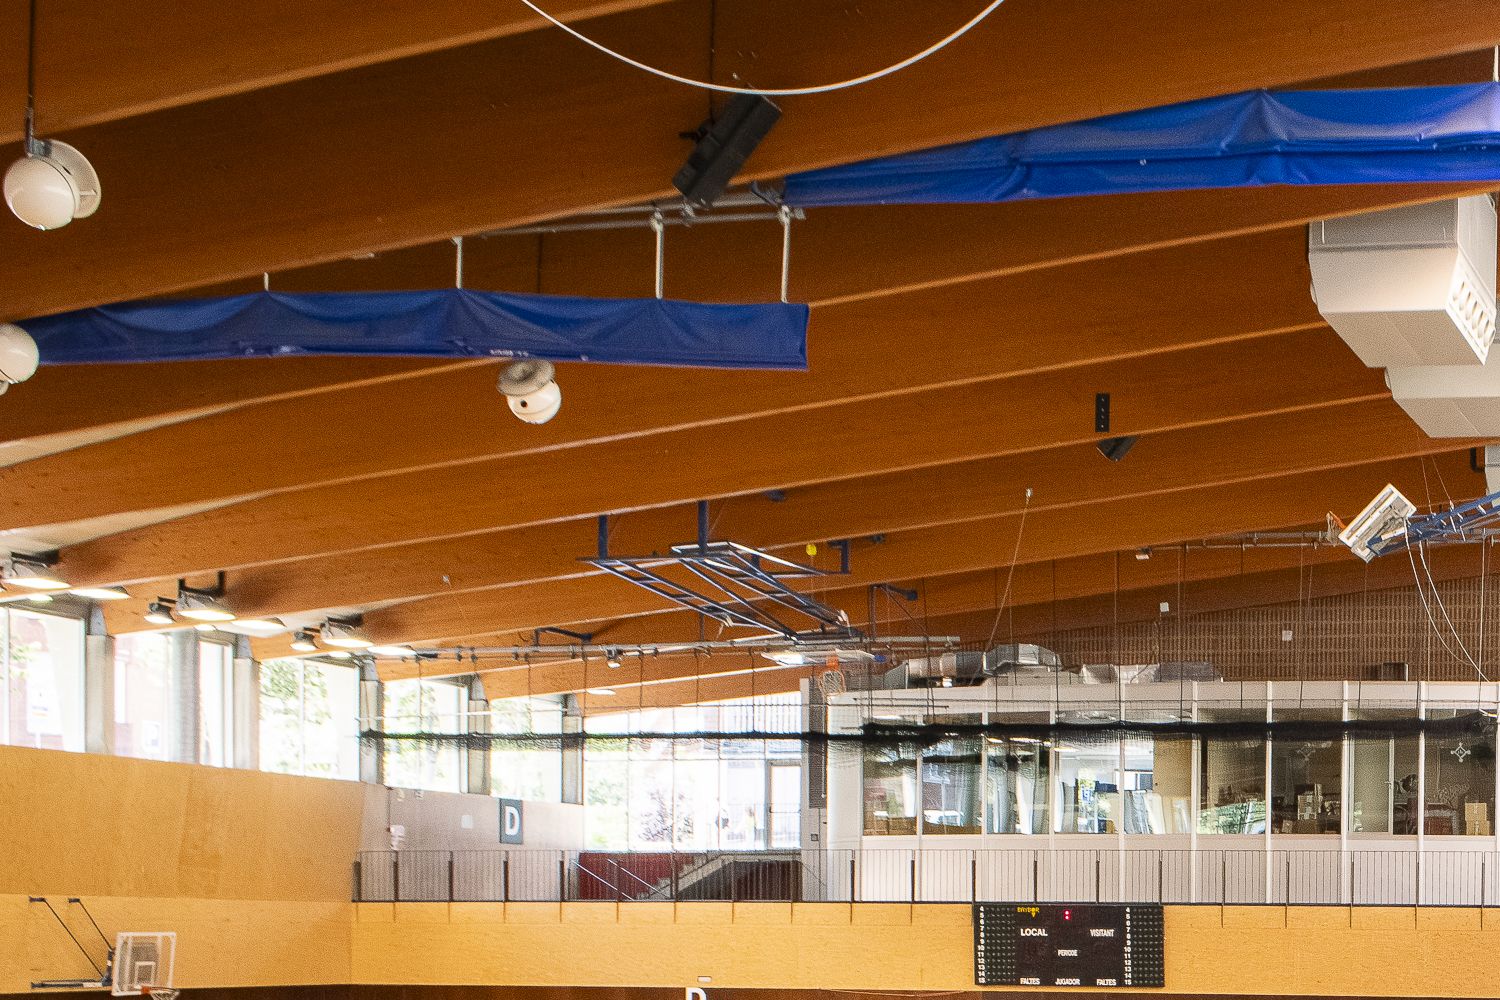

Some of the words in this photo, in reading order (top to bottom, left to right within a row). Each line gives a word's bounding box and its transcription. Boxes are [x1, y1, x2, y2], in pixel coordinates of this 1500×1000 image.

[505, 806, 520, 835] D
[1020, 928, 1048, 936] LOCAL
[1089, 928, 1115, 937] VISITANT
[1020, 977, 1040, 985] FALTES
[1096, 978, 1117, 986] FALTES
